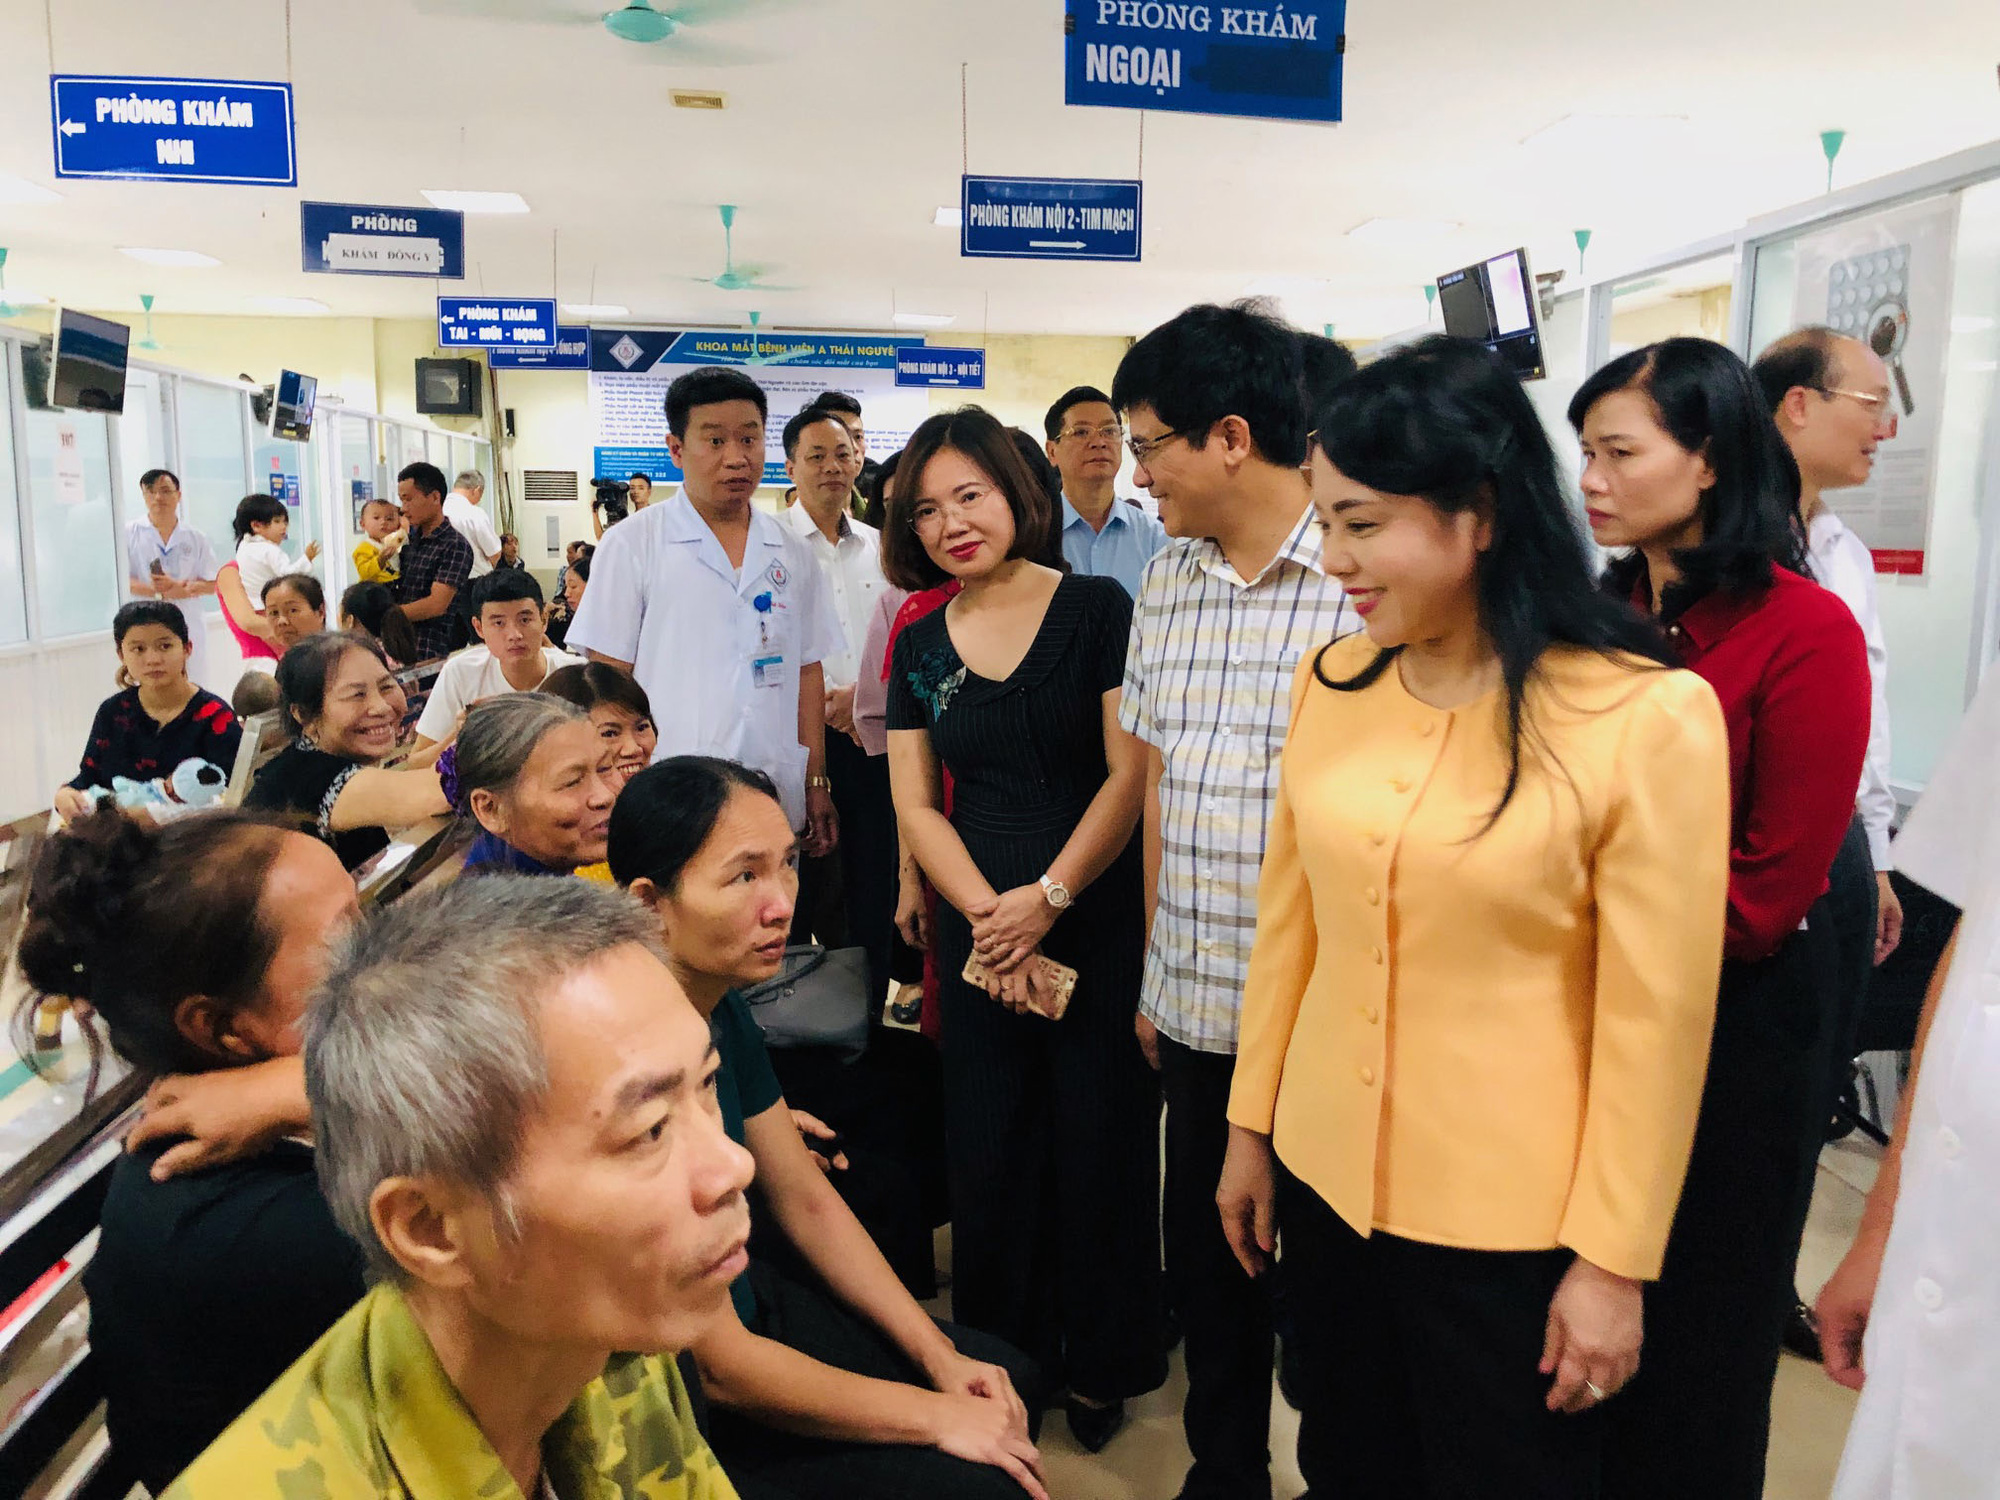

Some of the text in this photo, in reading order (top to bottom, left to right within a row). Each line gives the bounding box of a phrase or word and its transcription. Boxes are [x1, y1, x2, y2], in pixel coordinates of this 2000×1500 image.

[1220, 3, 1318, 41] KHÁM
[1086, 43, 1181, 95] NGOẠI
[95, 92, 253, 128] PHÒNG KHÁM
[156, 138, 195, 165] NHI
[351, 212, 418, 233] PHÒNG
[970, 200, 1009, 227] PHÒNG
[1011, 202, 1044, 229] KHÁM
[1045, 203, 1066, 233] NỘI
[1102, 208, 1134, 234] MẠCH
[342, 249, 378, 260] KHÁM
[387, 249, 421, 261] ĐÔNG
[458, 304, 538, 322] PHÒNG KHÁM
[449, 327, 468, 340] TAI
[513, 327, 546, 343] HỌNG
[696, 341, 728, 352] KHOA
[818, 345, 826, 355] A
[829, 343, 854, 355] THÁI
[857, 344, 895, 357] NGUYÊ
